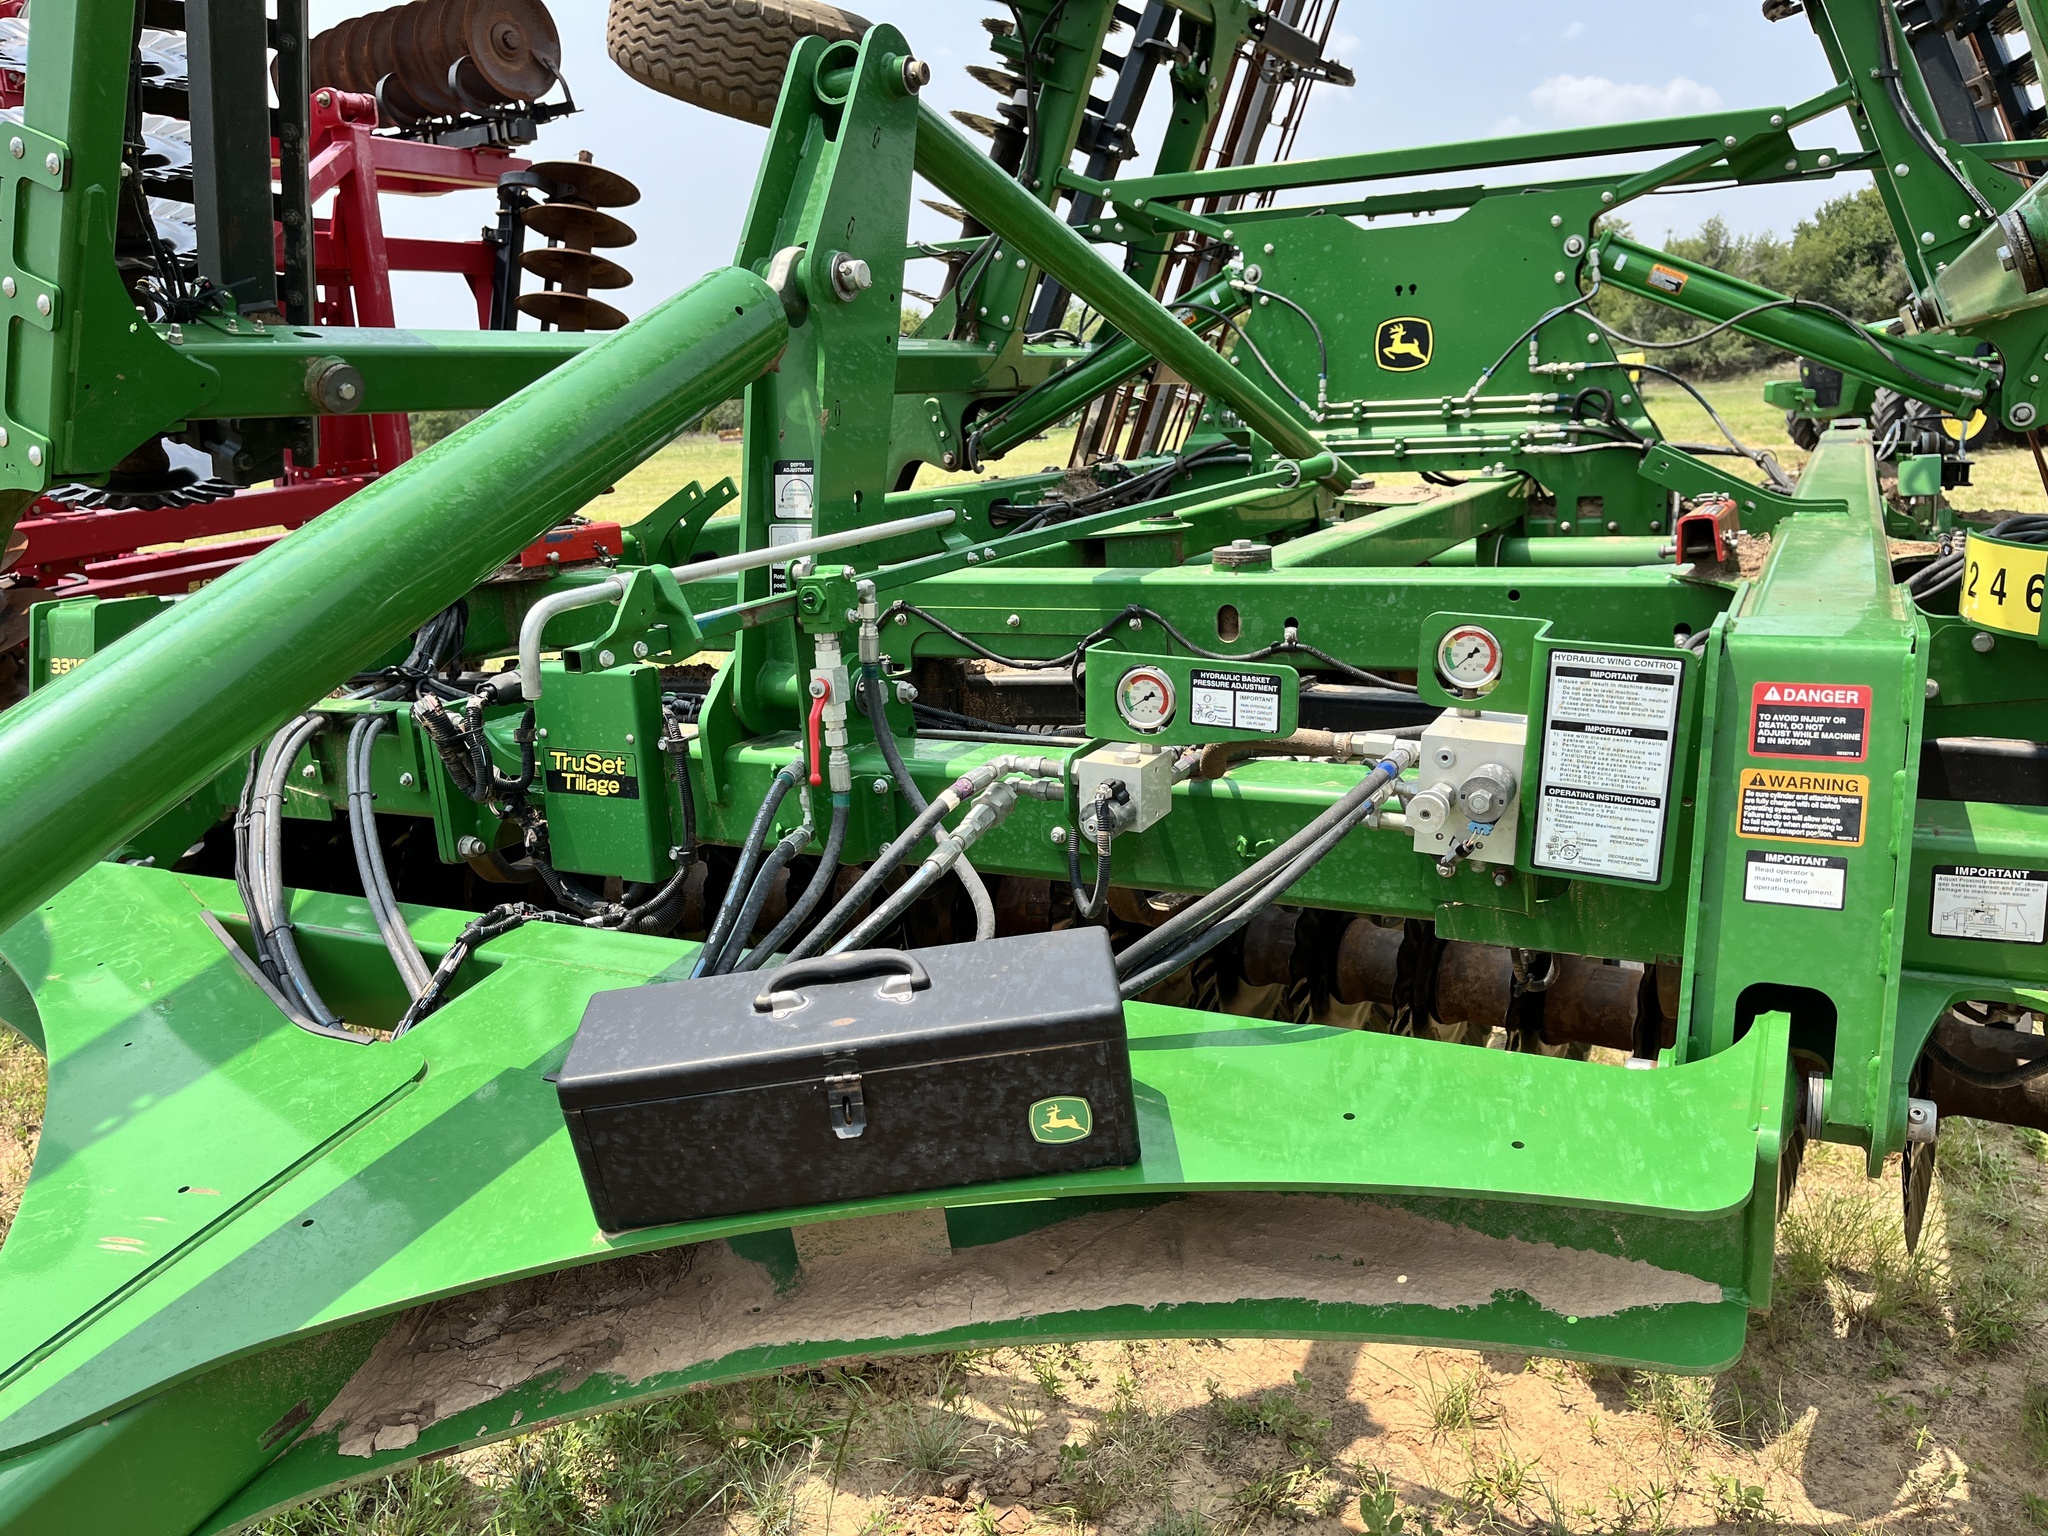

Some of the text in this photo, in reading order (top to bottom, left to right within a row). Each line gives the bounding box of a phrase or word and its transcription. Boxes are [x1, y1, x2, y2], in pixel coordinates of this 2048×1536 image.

[1554, 651, 1678, 670] HYDRAULIC WING CONTROL
[1200, 671, 1270, 683] HYDRAULIC BASKET
[1589, 669, 1638, 681] IMPORTANT
[1194, 678, 1277, 692] PRESSURE ADJUSTMENT
[1239, 694, 1273, 702] IMPORTANT
[1783, 689, 1859, 704] DANGER
[1772, 713, 1799, 722] AVOID
[1800, 714, 1831, 723] INJURY
[1832, 716, 1846, 724] OR
[1584, 724, 1632, 735] IMPORTANT
[1758, 720, 1823, 731] DEATH, DO NOT
[1757, 728, 1860, 740] ADJUST WHILE MACHINE
[1777, 737, 1810, 746] MOTION
[550, 751, 625, 775] TruSet
[561, 772, 620, 796] Tillage
[1769, 775, 1859, 792] WARNING
[1548, 787, 1656, 806] OPERATING INSTRUCTIONS
[1769, 791, 1795, 800] cylinder
[1808, 794, 1838, 803] attaching
[1838, 796, 1859, 804] hoses
[1743, 803, 1798, 814] operating system.
[1755, 797, 1769, 805] fully
[1769, 798, 1796, 807] charged
[1819, 801, 1840, 810] before
[1743, 810, 1764, 818] Failure
[1803, 814, 1820, 822] allow
[1760, 818, 1782, 827] rapidly
[1800, 821, 1835, 831] attempting
[1775, 827, 1805, 836] transport
[1805, 829, 1833, 839] position.
[1765, 853, 1828, 867] IMPORTANT
[1775, 868, 1814, 877] operator's
[1955, 866, 2030, 879] IMPORTANT
[1752, 884, 1833, 897] operating equipment.
